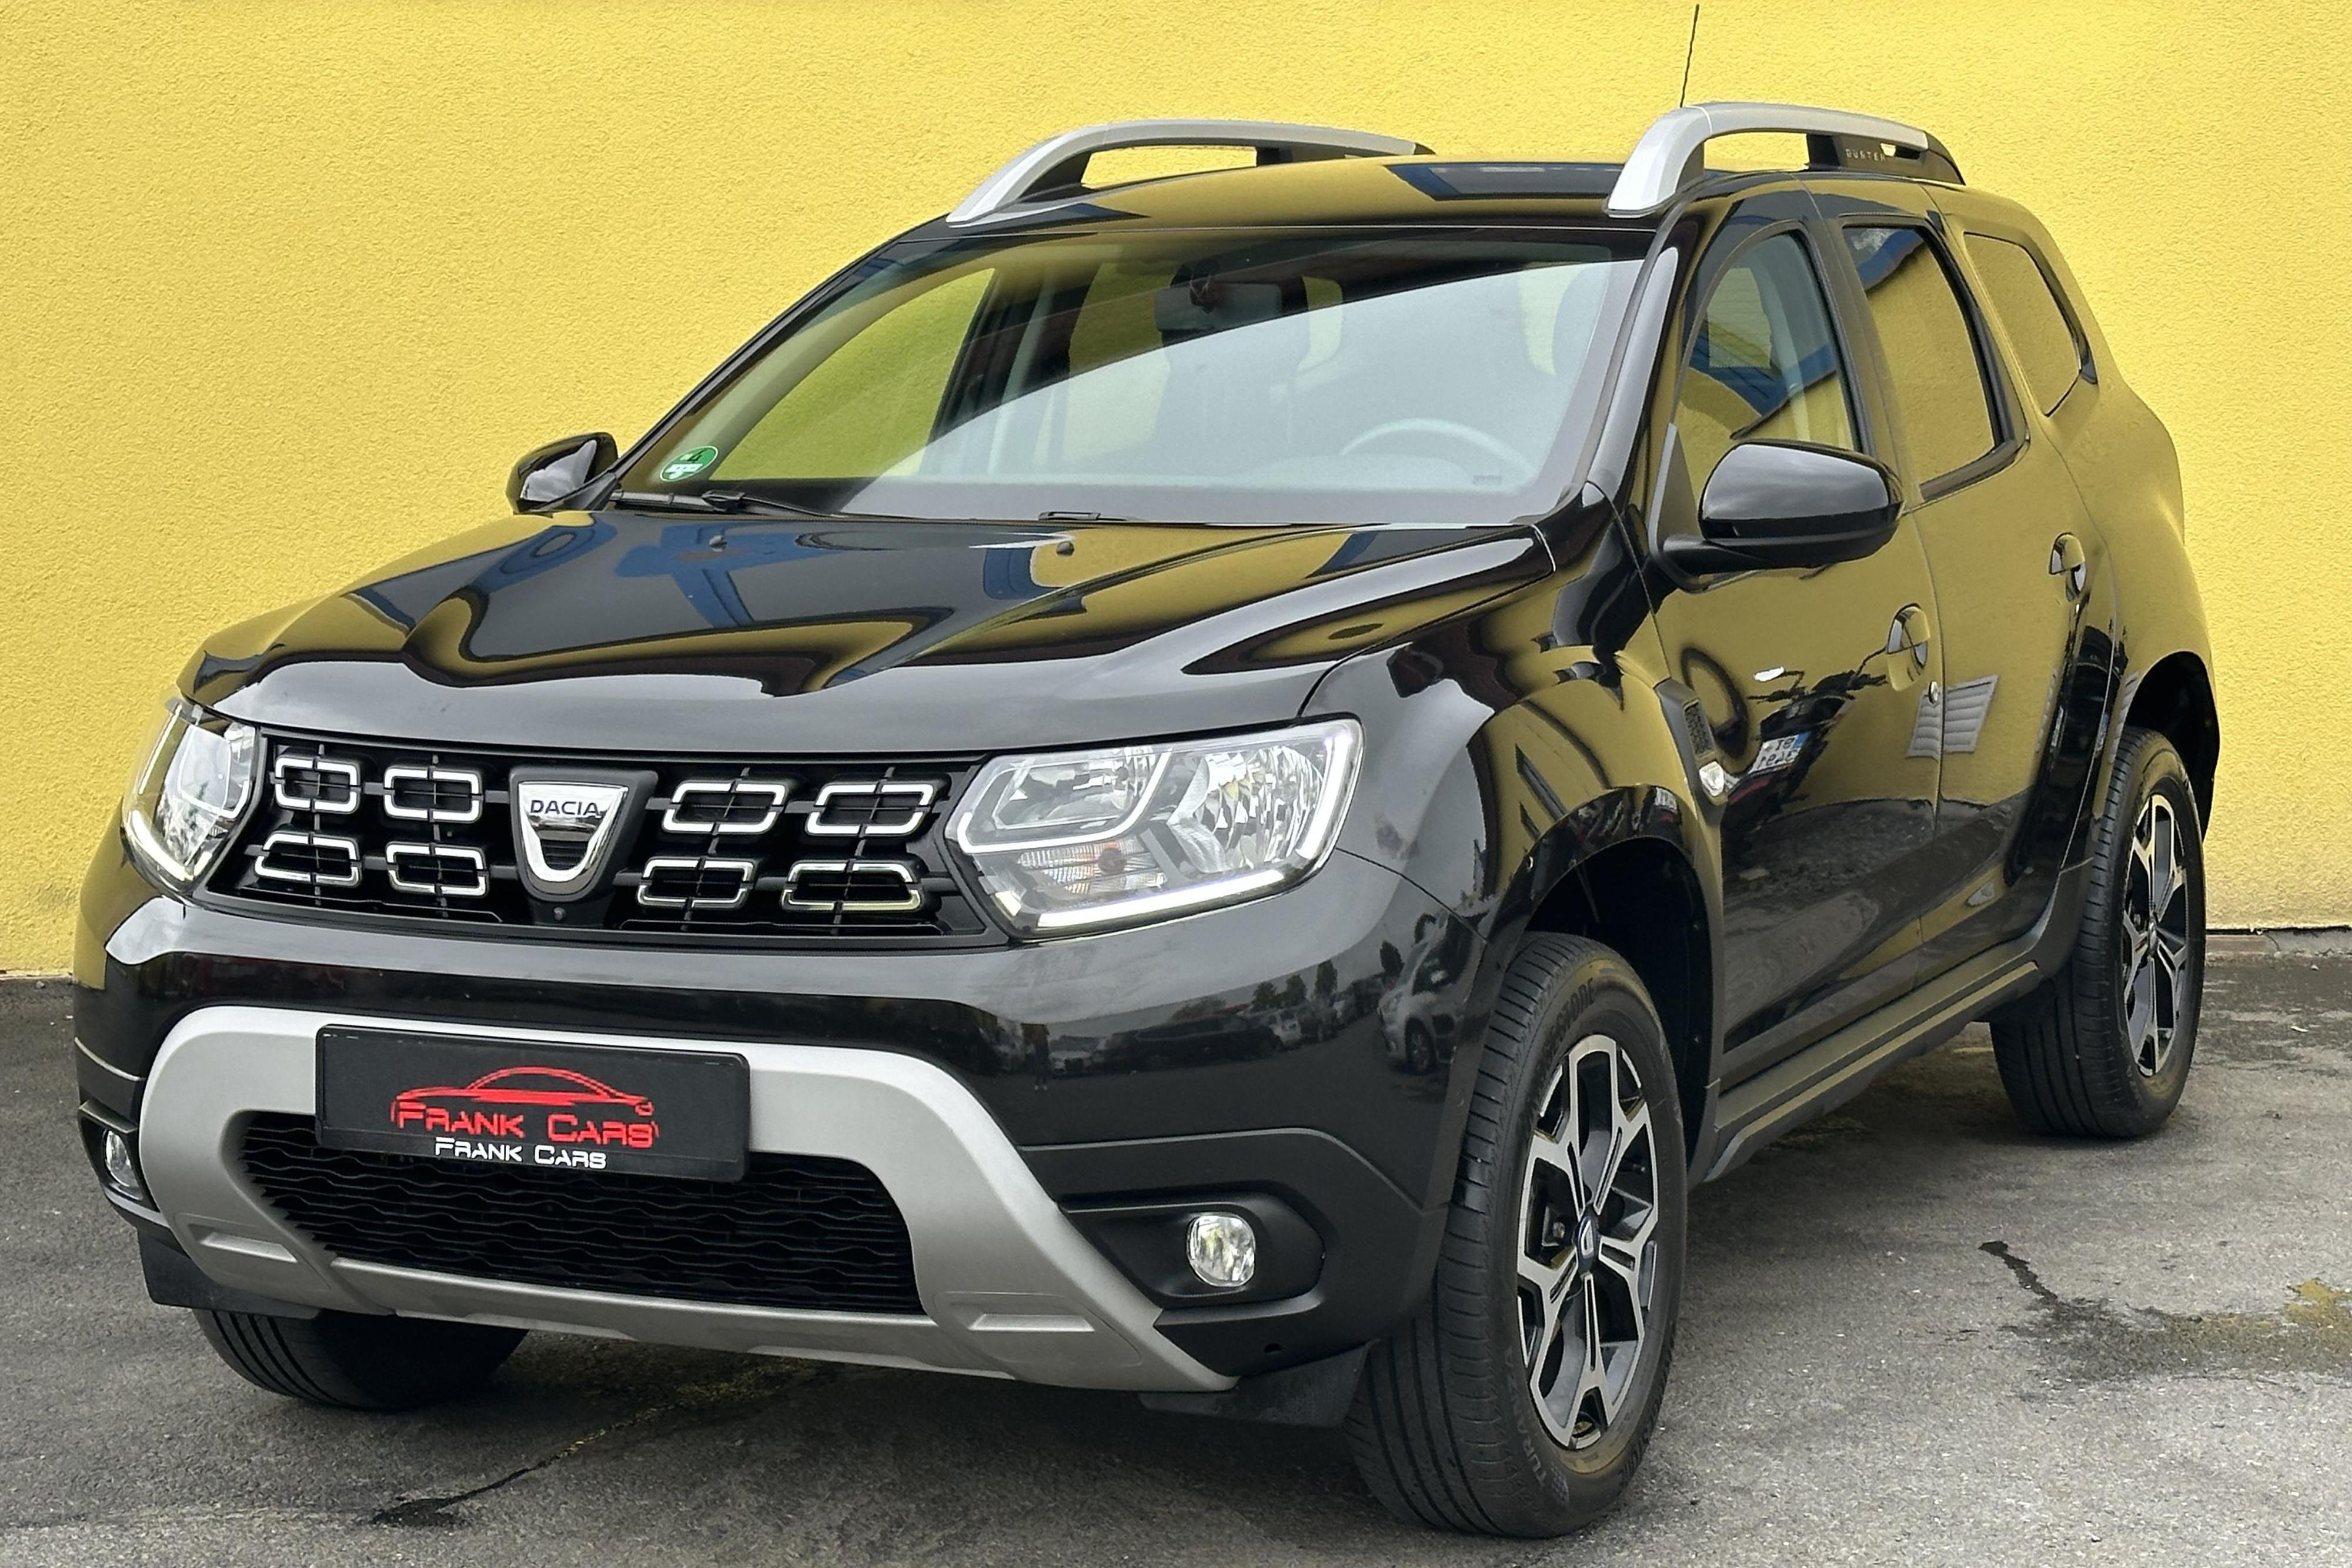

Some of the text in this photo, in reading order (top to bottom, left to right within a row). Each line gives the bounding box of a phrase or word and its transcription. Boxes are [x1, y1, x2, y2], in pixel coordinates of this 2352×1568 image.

[1845, 149, 1885, 162] DUSTER
[530, 800, 600, 816] DACIA
[397, 1102, 653, 1148] FRANK CARS
[435, 1136, 606, 1169] FRANK CARS
